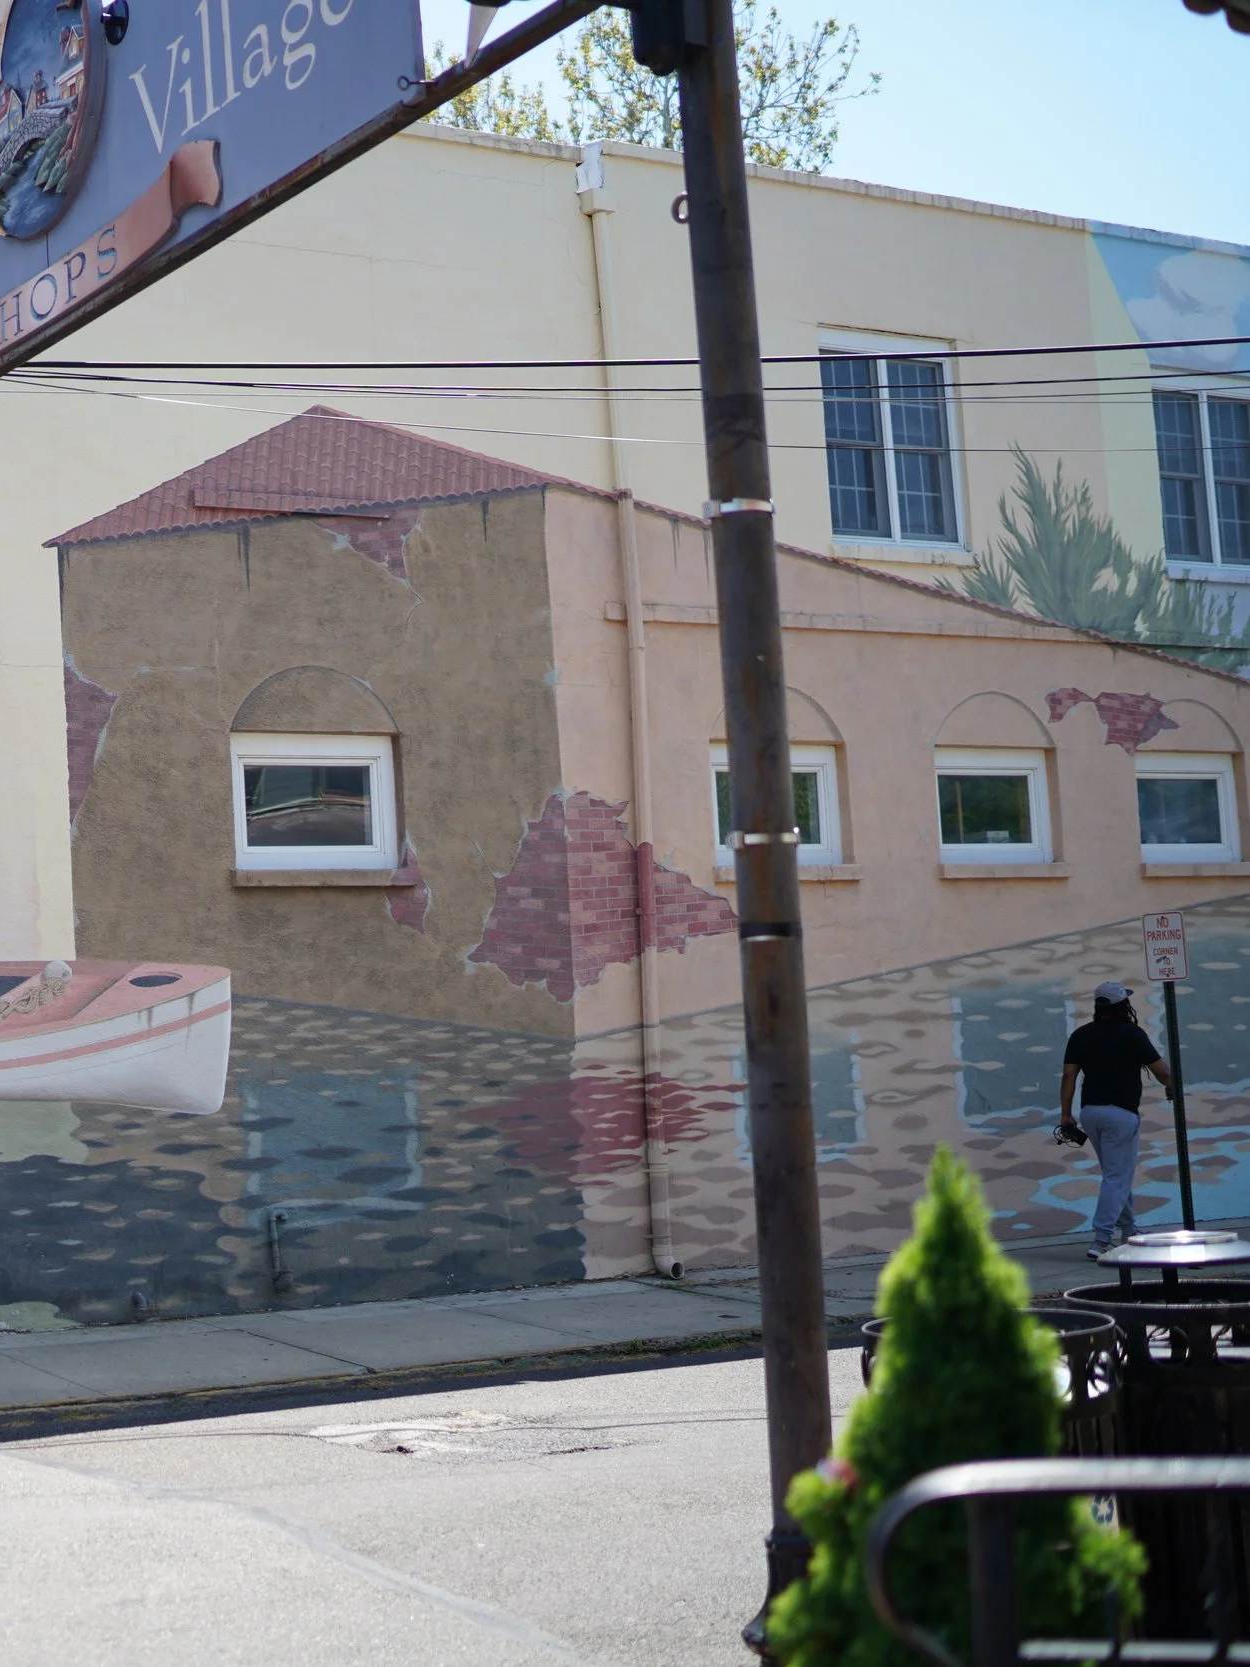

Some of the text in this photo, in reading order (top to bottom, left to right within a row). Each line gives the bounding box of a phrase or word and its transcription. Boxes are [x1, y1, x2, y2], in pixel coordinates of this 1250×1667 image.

[1156, 917, 1169, 928] NO
[1146, 929, 1182, 941] PARKING
[1152, 947, 1179, 956] CORNER
[1158, 967, 1176, 975] HERE
